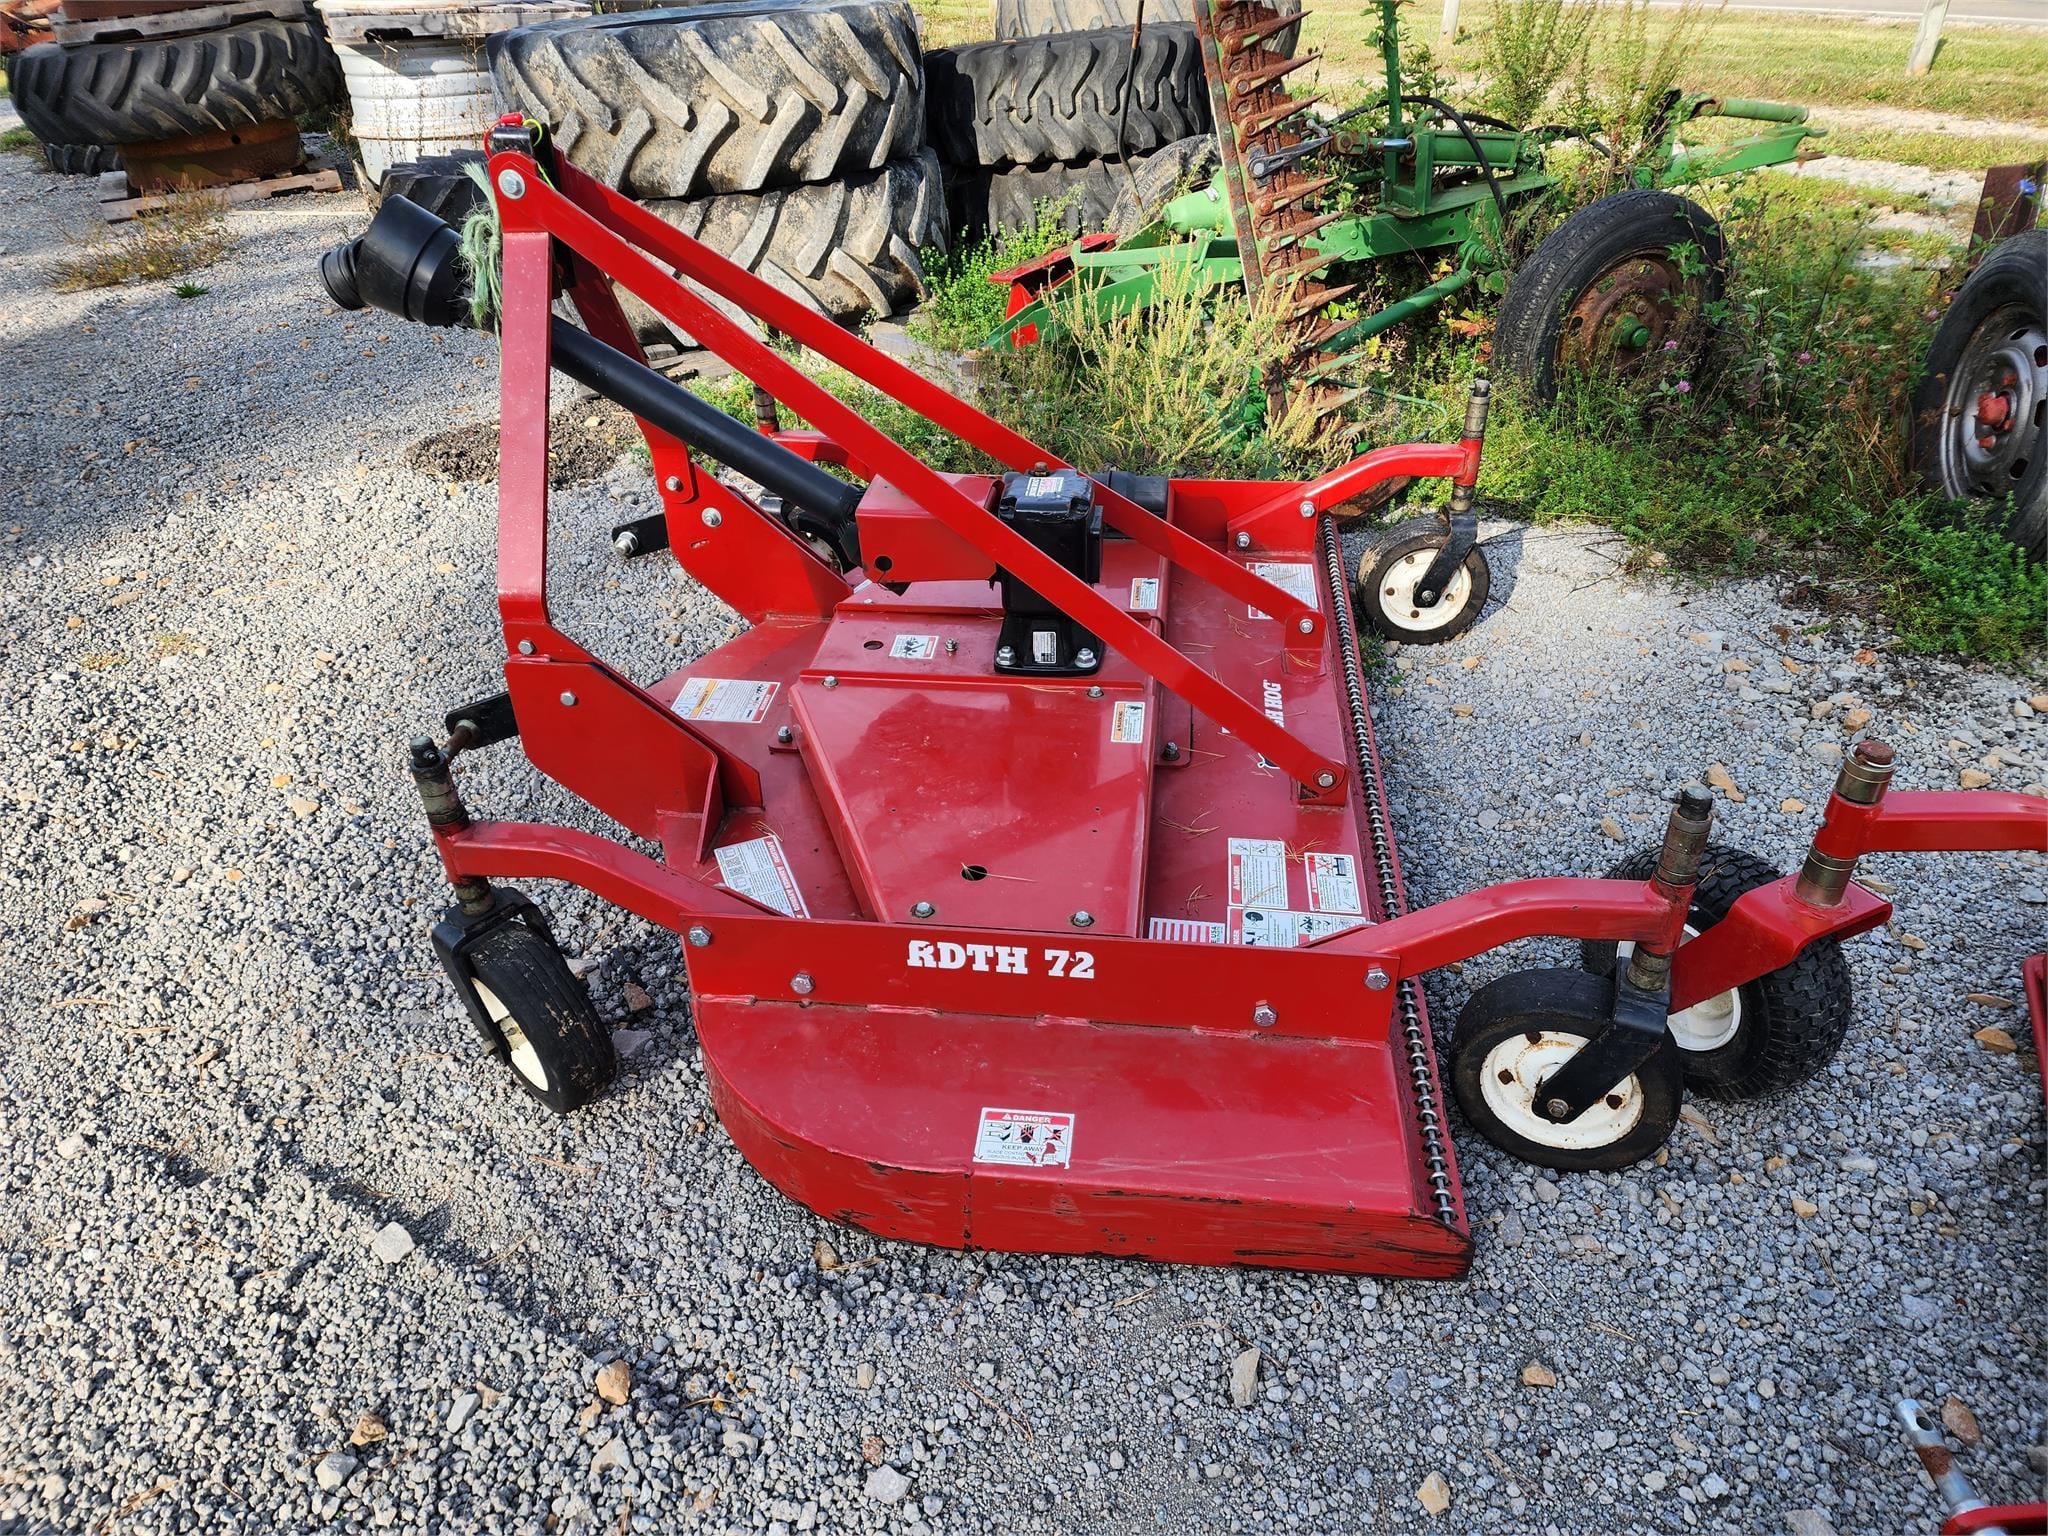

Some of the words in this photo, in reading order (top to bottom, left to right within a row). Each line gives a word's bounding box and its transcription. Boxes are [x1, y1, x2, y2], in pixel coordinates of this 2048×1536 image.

[1263, 682, 1283, 709] HOG
[907, 939, 1029, 975] RDTH
[1044, 949, 1095, 979] 72
[1013, 1114, 1052, 1124] DANGER
